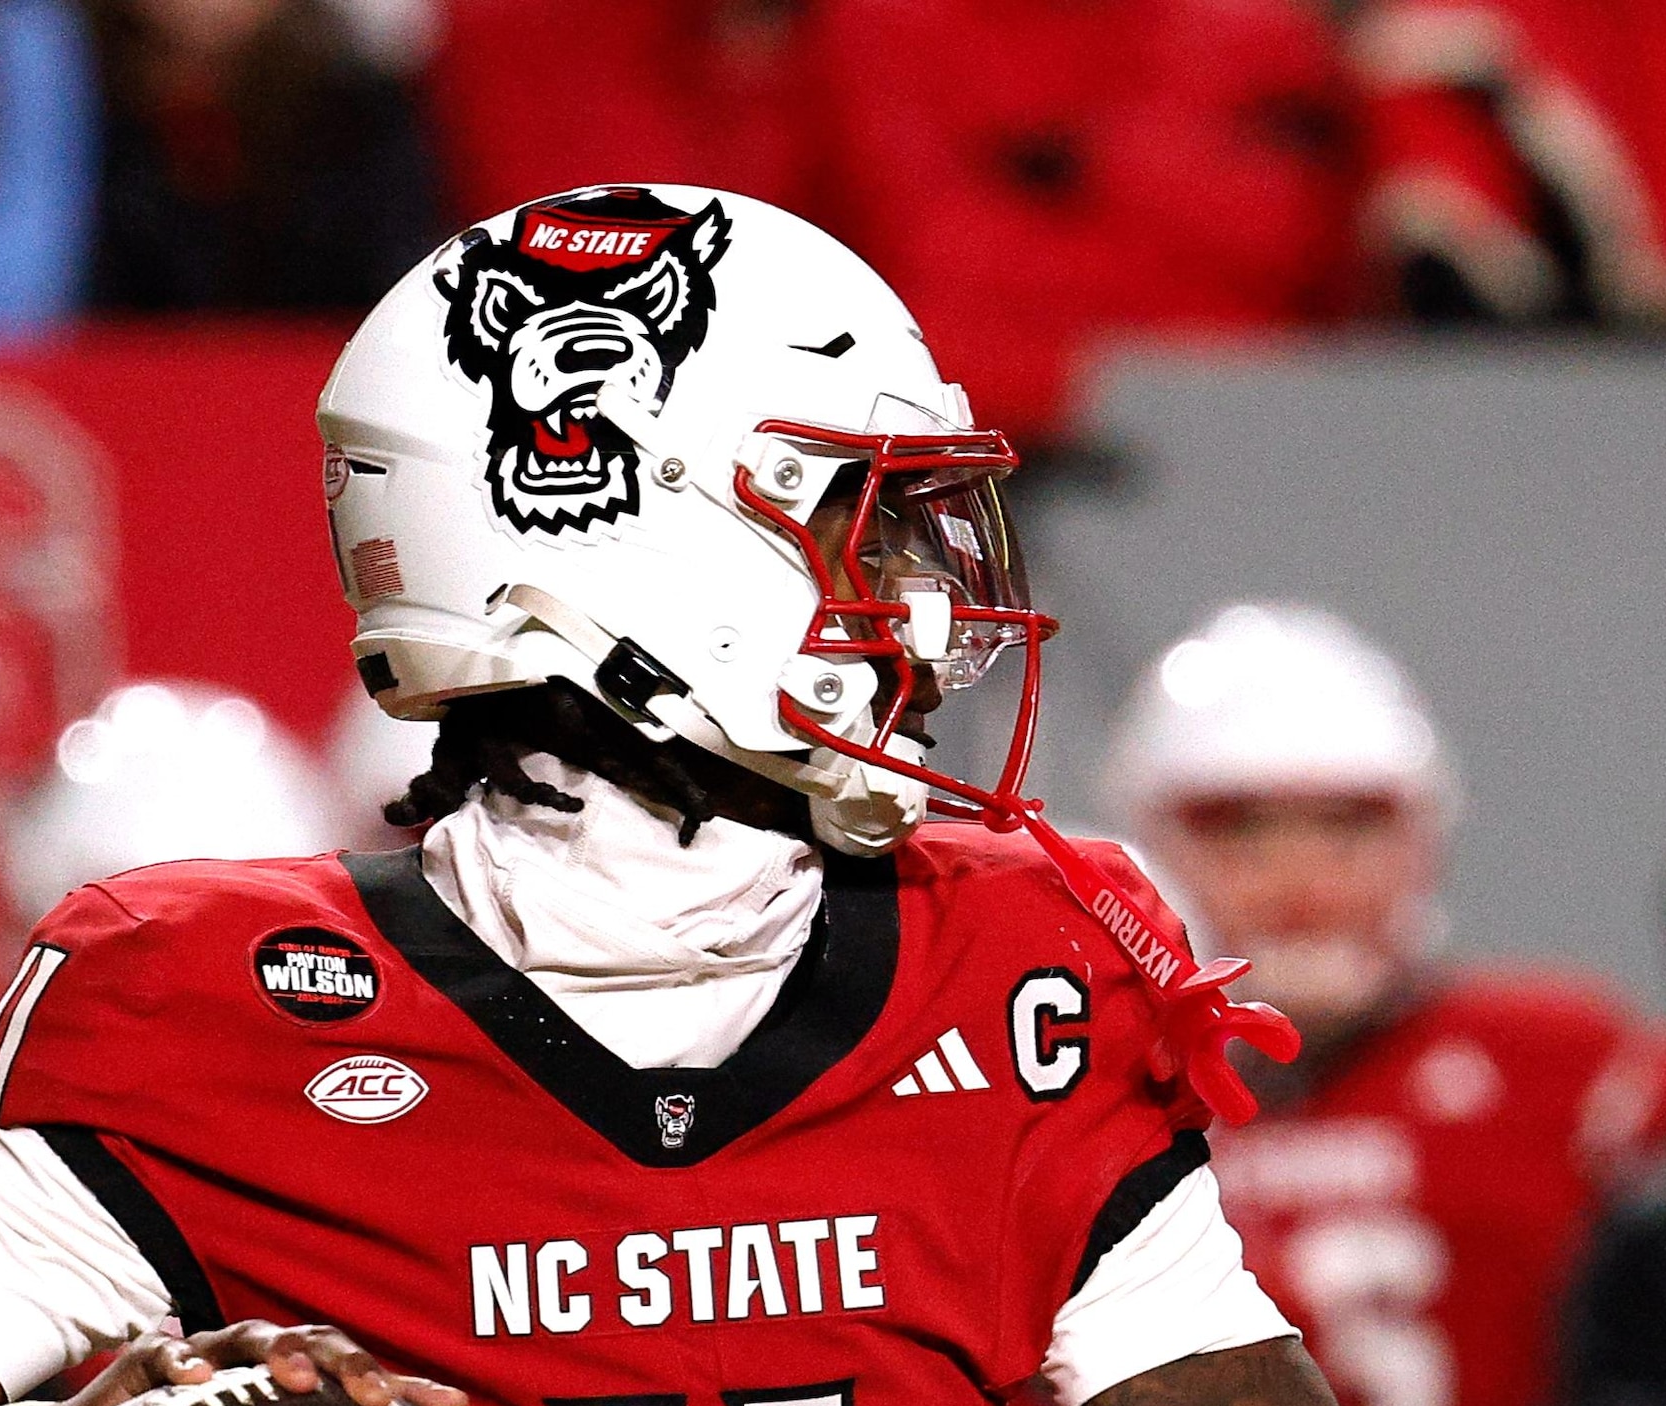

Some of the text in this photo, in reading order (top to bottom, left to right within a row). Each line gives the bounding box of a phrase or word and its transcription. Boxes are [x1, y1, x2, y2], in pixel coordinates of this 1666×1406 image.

[528, 223, 652, 256] NC STATE
[1091, 887, 1181, 989] NXTRND
[286, 952, 347, 974] PAYTON
[262, 964, 374, 998] WILSON
[1007, 967, 1090, 1105] C
[325, 1075, 408, 1097] ACC
[468, 1214, 886, 1338] NC STATE
